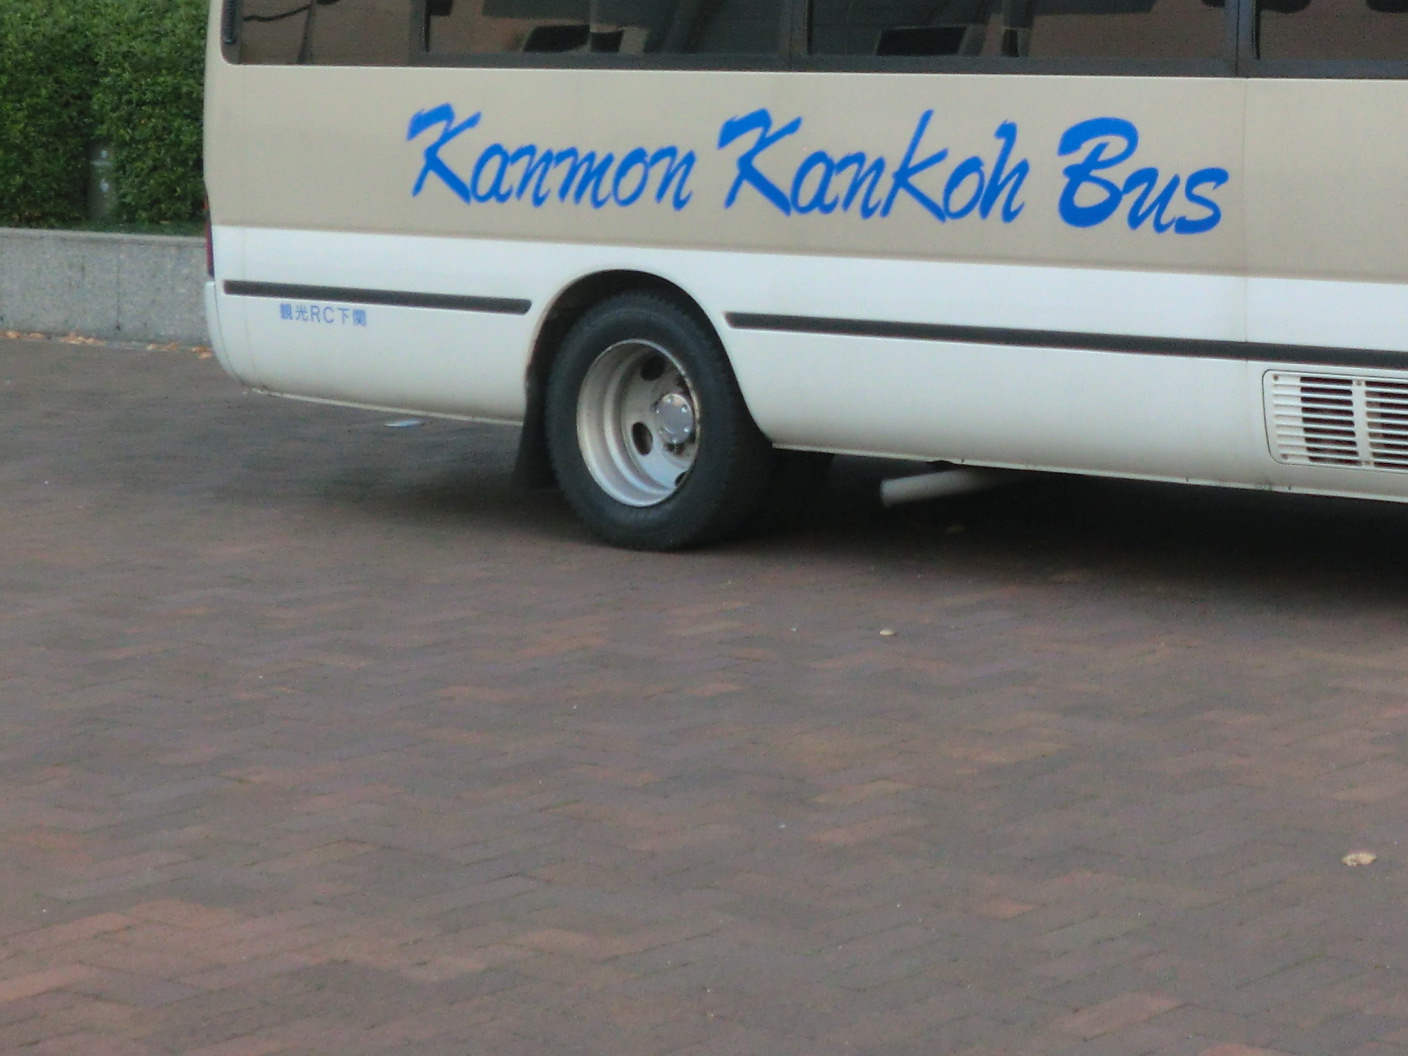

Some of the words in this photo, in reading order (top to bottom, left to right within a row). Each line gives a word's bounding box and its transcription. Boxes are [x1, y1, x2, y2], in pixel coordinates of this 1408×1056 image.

[407, 104, 696, 210] Kanmon
[718, 108, 1030, 223] Kankoh
[1058, 117, 1229, 234] Bus
